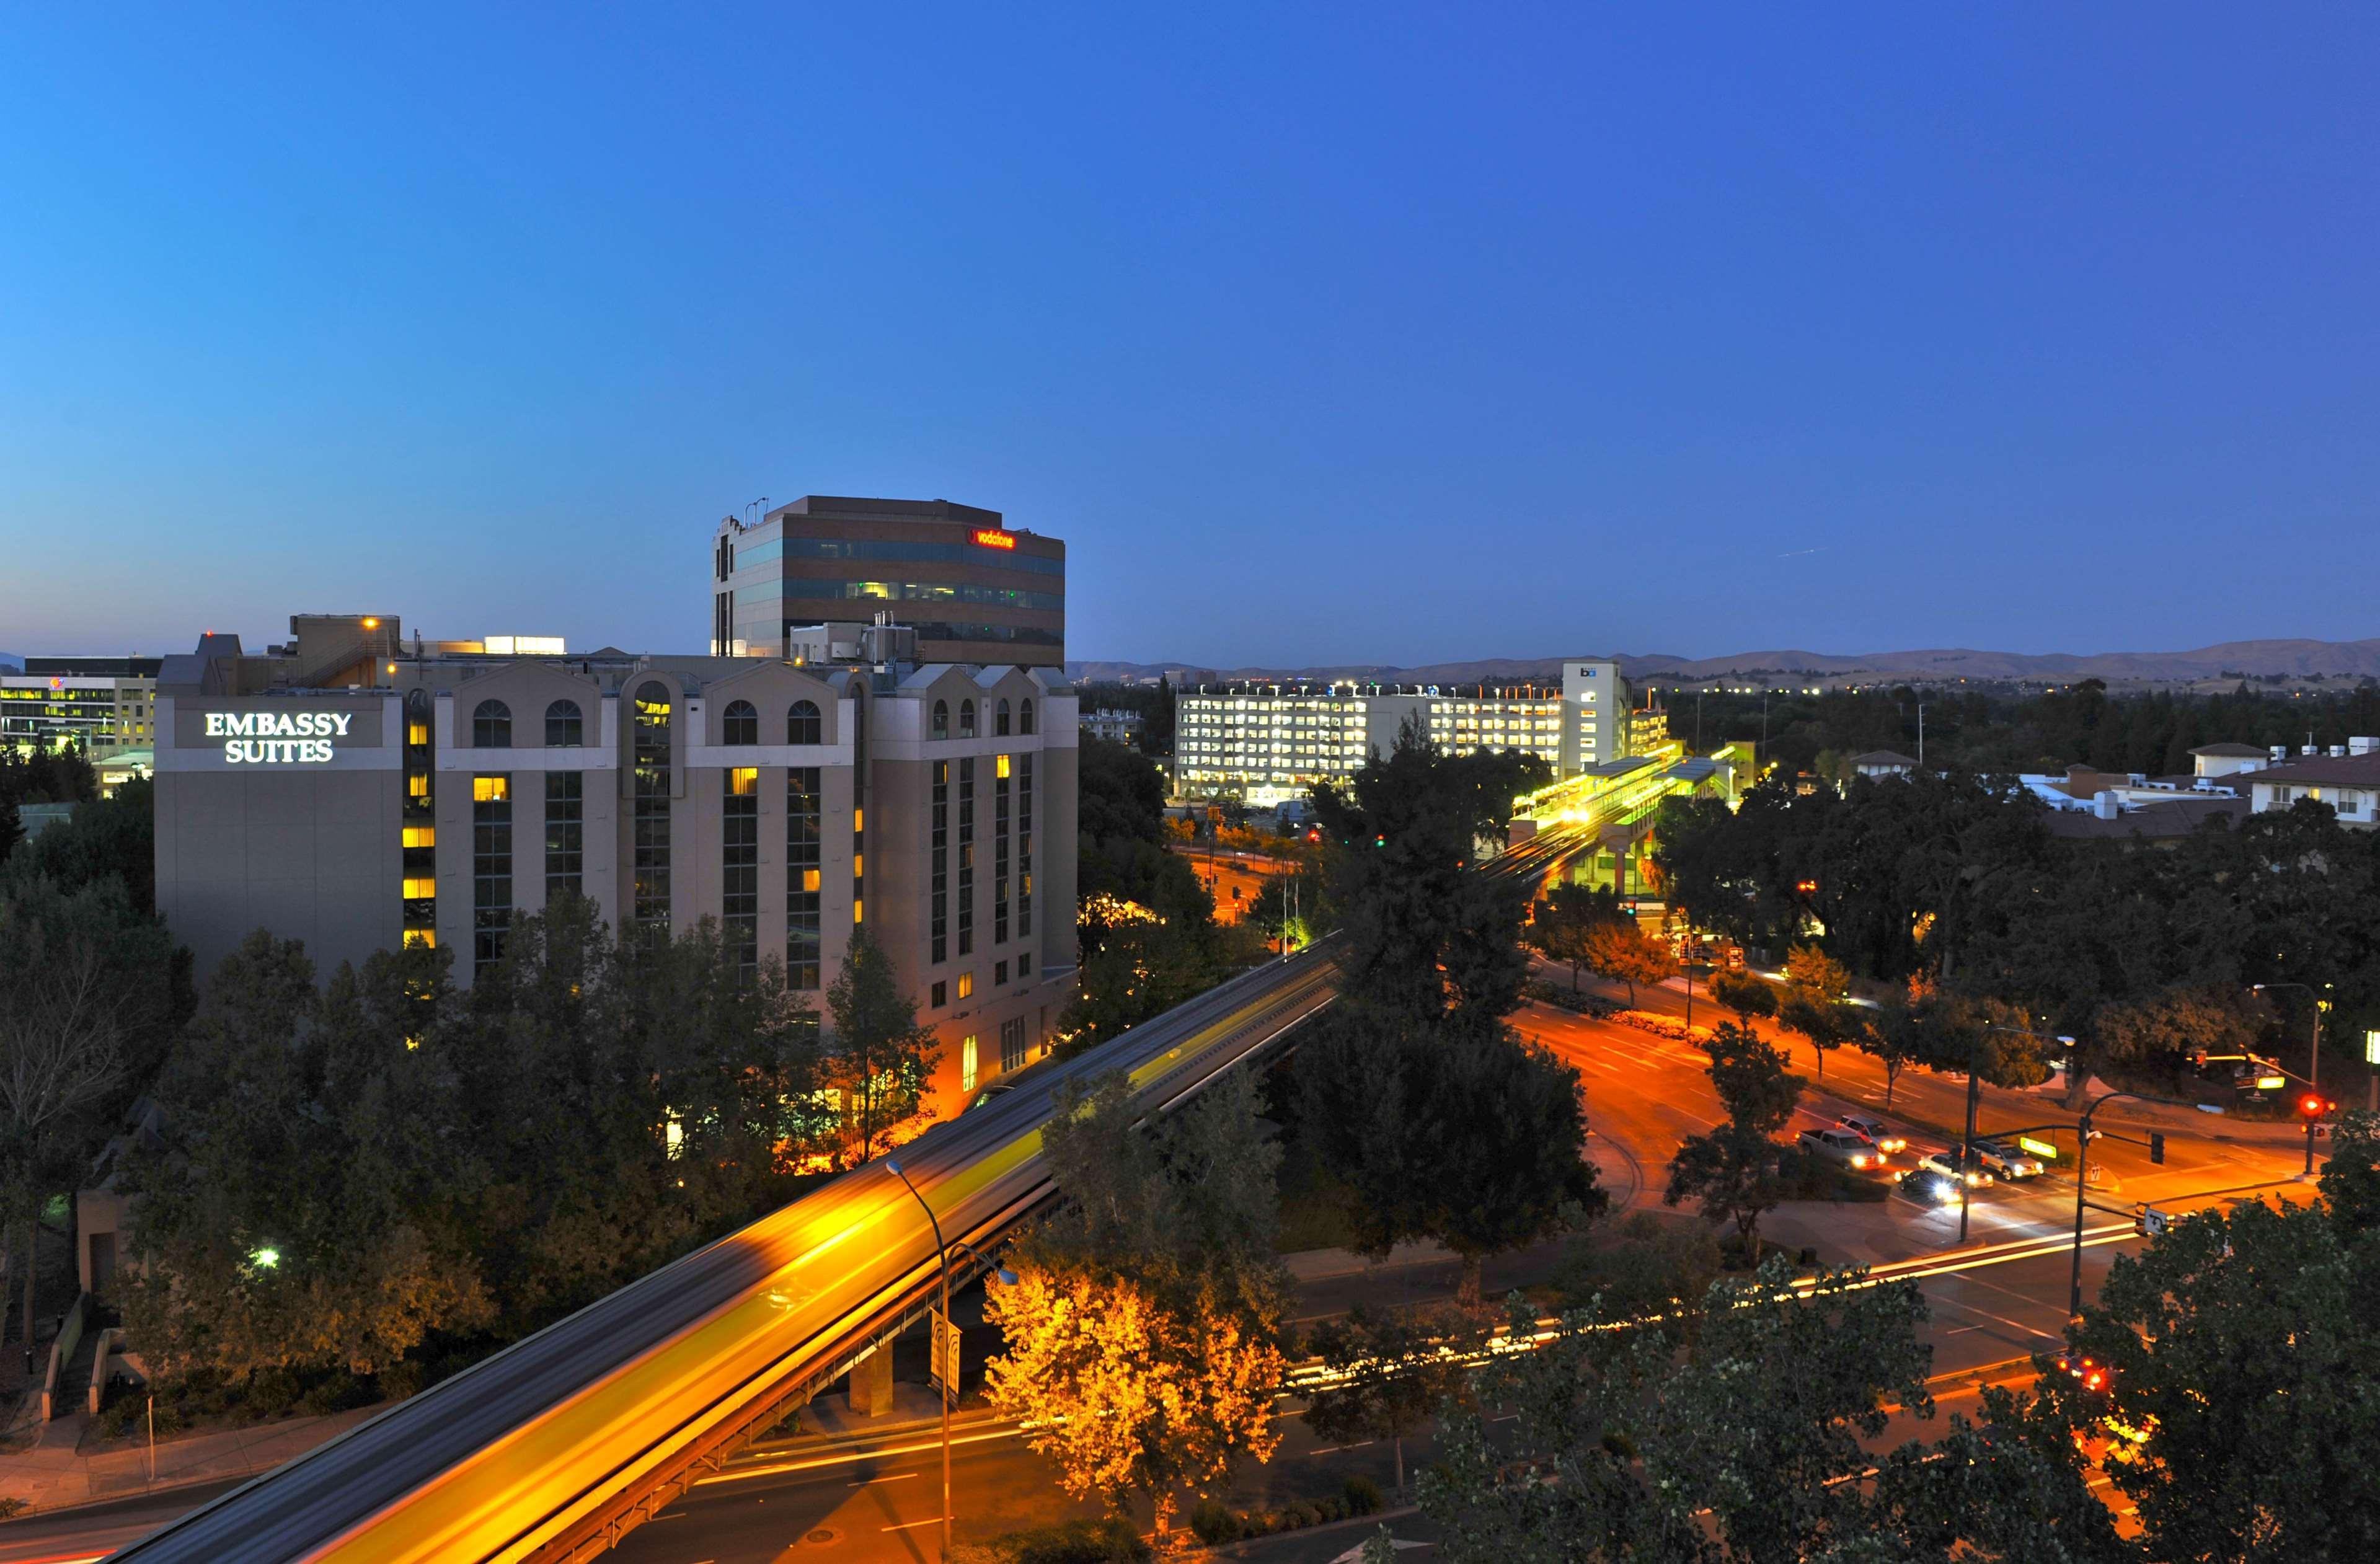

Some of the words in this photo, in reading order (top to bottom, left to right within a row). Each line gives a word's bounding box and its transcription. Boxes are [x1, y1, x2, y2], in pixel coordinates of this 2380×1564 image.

[978, 530, 1013, 548] vodafone
[205, 713, 352, 736] EMBASSY
[225, 740, 334, 763] SUITES
